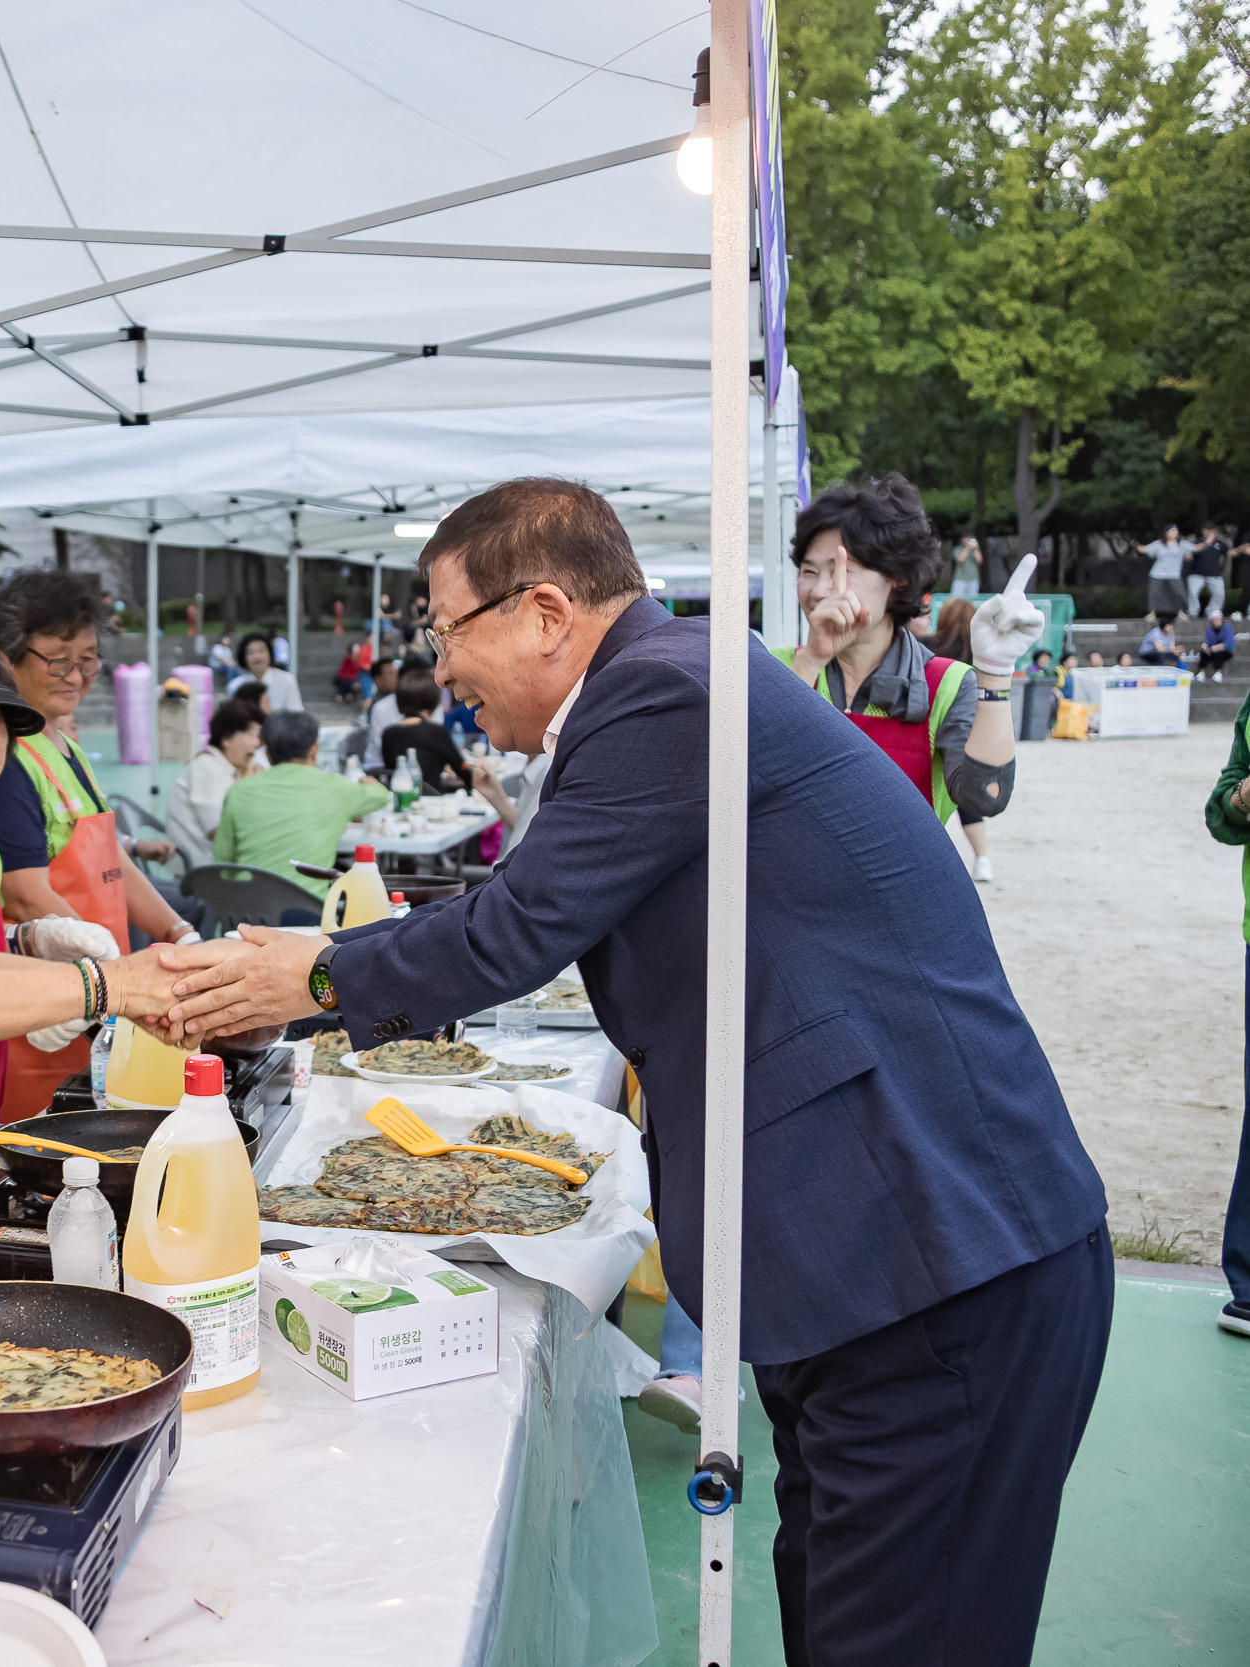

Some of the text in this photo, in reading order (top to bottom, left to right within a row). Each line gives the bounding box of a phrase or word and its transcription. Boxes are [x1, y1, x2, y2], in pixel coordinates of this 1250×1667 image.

[313, 974, 329, 988] 53
[316, 988, 333, 1003] 05
[318, 1331, 346, 1357] 위생장갑
[380, 1329, 422, 1349] 위생장갑
[380, 1345, 423, 1359] Clean Gloves
[319, 1349, 346, 1379] 500매
[404, 1355, 423, 1366] 500매
